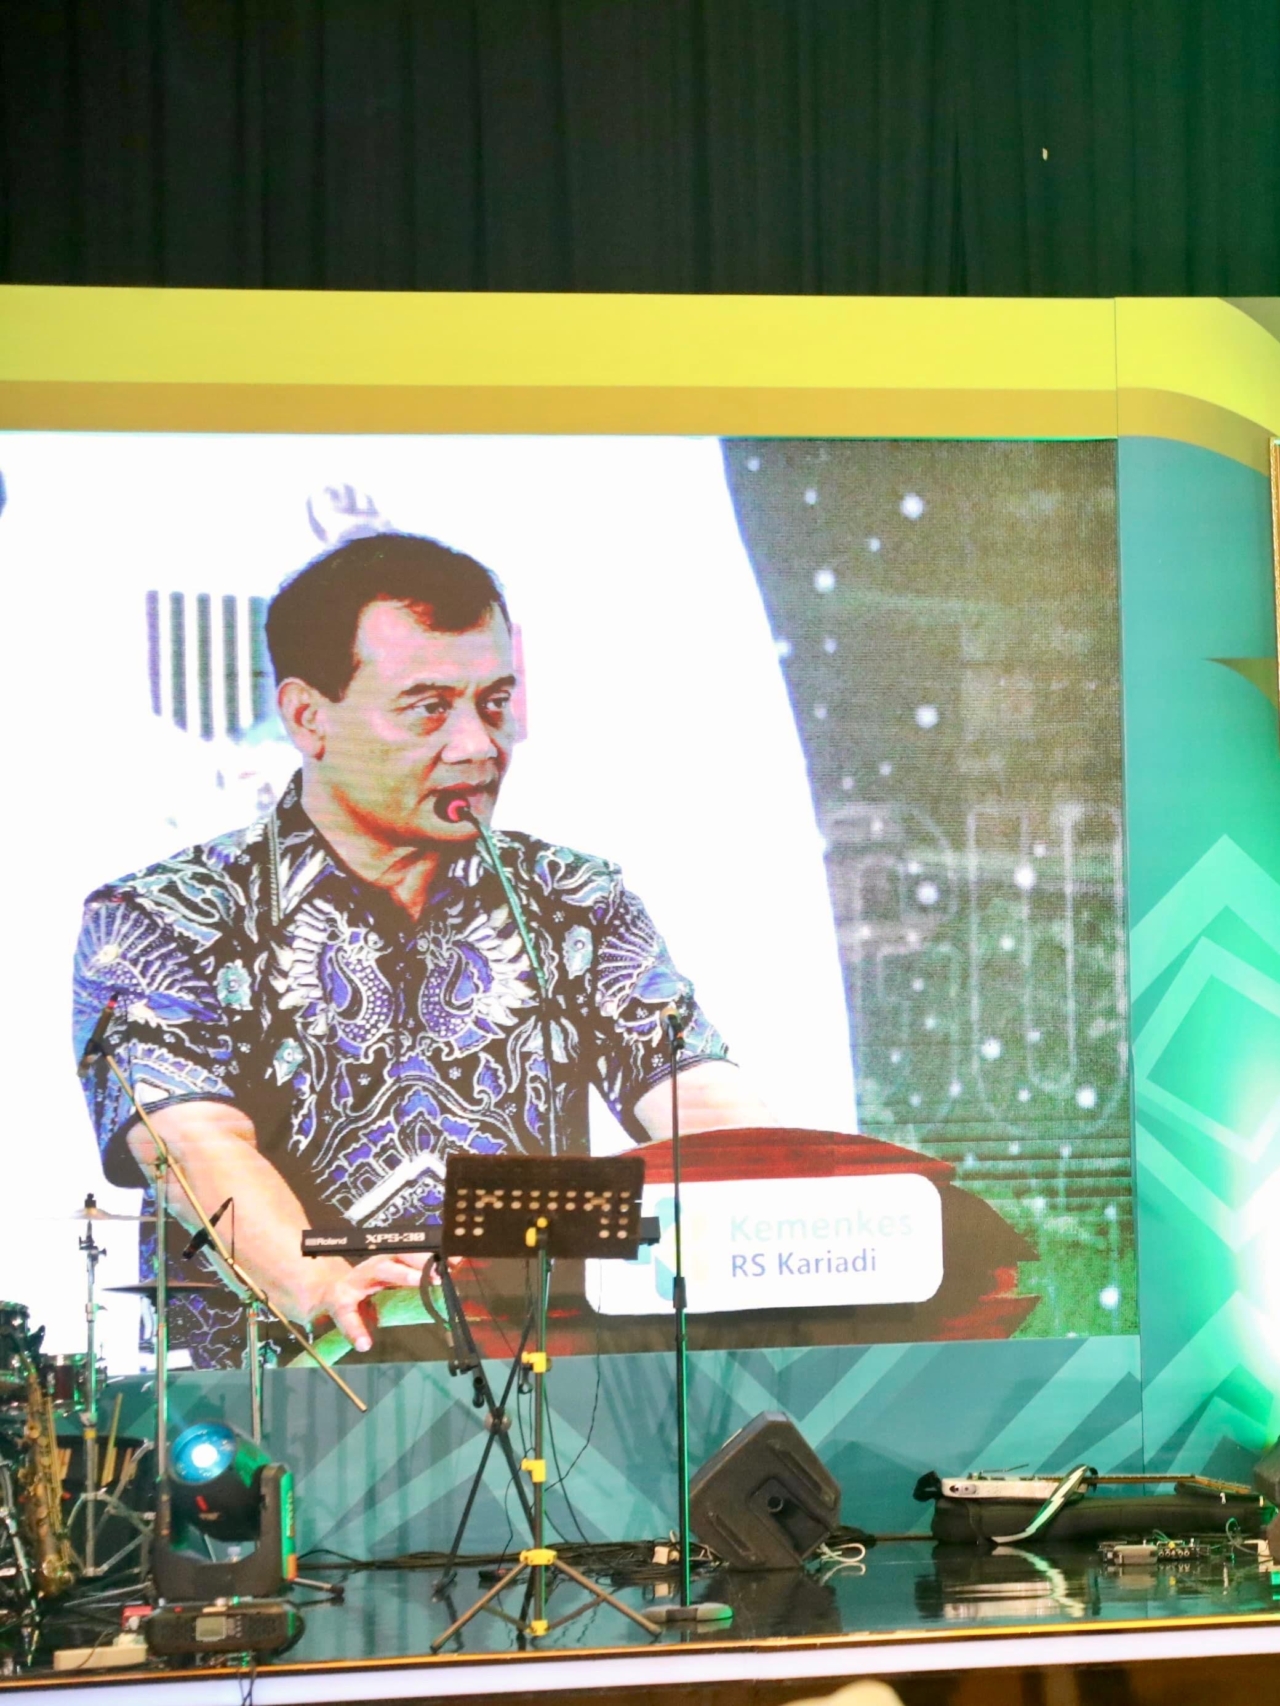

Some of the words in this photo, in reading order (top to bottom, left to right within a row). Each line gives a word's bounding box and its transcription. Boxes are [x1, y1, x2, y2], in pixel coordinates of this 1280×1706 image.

[316, 1236, 348, 1246] Roland
[365, 1231, 426, 1244] XPS-30
[730, 1208, 913, 1243] Kemenkes
[731, 1252, 767, 1278] RS
[777, 1247, 877, 1276] Kariadi
